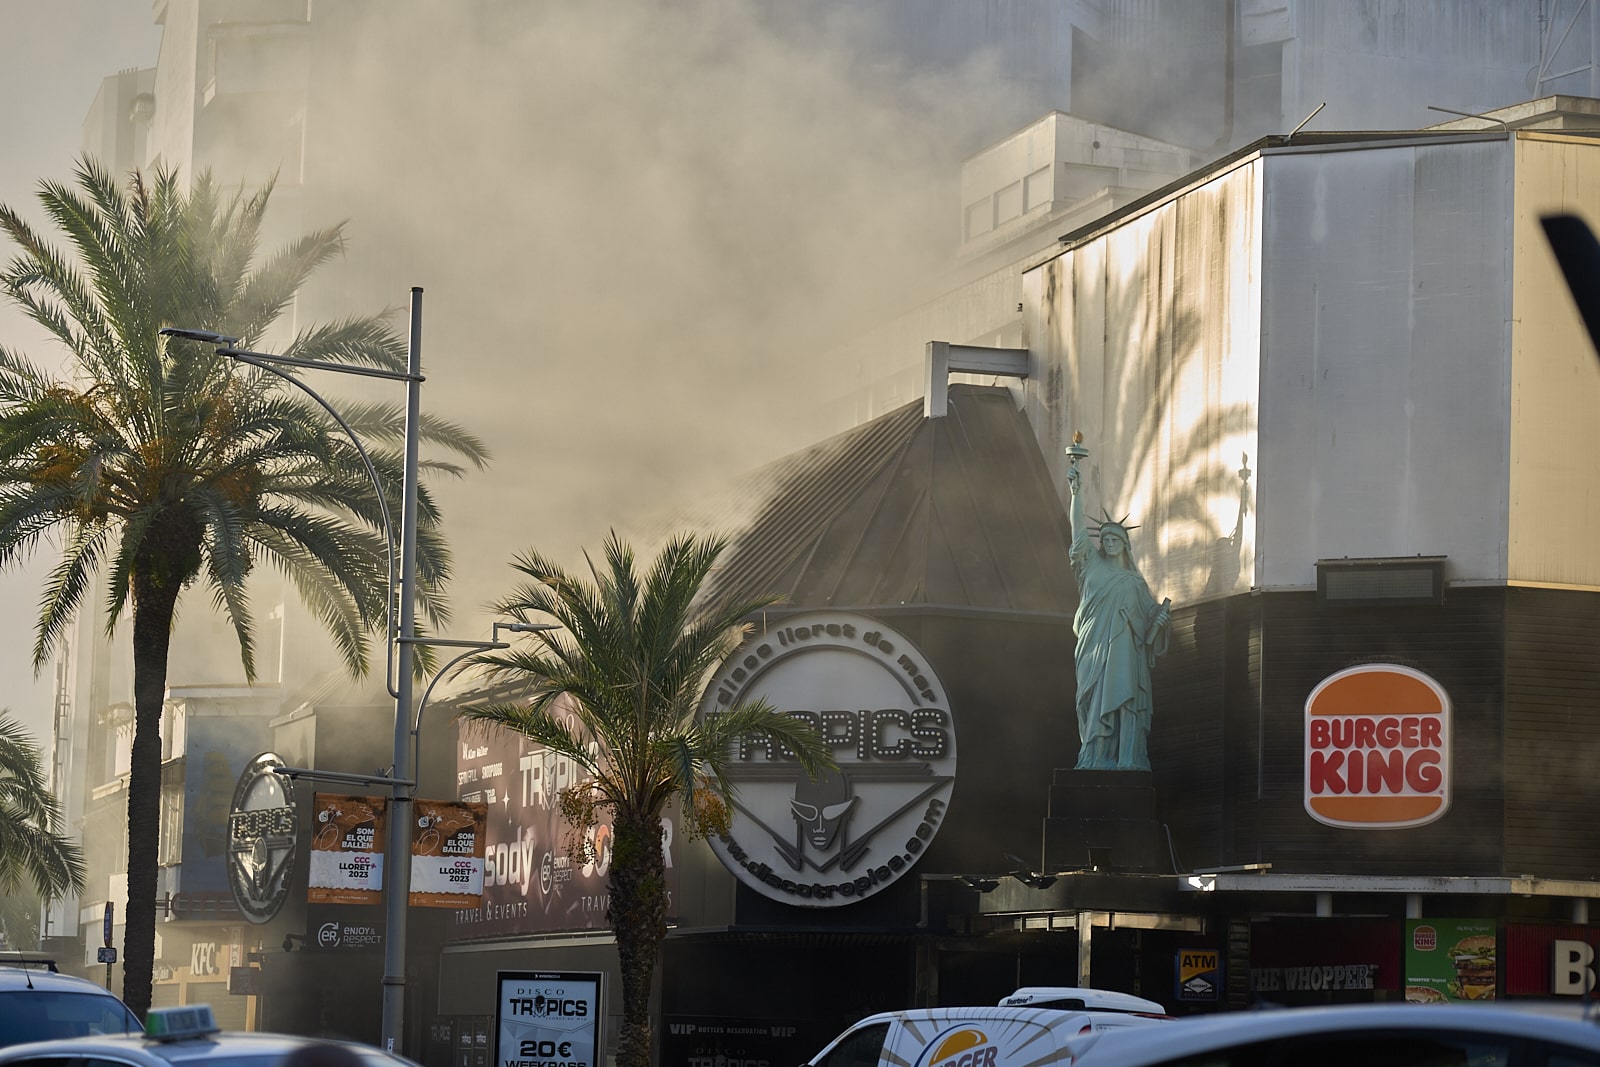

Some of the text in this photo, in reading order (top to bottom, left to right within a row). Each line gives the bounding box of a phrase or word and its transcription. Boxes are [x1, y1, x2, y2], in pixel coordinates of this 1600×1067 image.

[776, 623, 857, 648] lloret
[862, 630, 895, 655] de
[896, 653, 938, 703] mar
[1310, 717, 1443, 750] BURGER
[1309, 749, 1443, 795] KING
[356, 827, 375, 836] SOM
[457, 832, 475, 841] SOM
[346, 834, 374, 843] EL QUE
[447, 839, 475, 848] EL QUE
[341, 840, 374, 850] BALLEM
[442, 846, 474, 855] BALLEM
[353, 856, 371, 864] CCC
[454, 861, 472, 869] CCC
[484, 825, 535, 896] sody
[339, 862, 371, 872] LLORET
[439, 867, 472, 876] LLORET
[348, 870, 369, 879] 2023
[449, 875, 470, 883] 2023
[580, 894, 612, 914] TRAVE
[455, 910, 484, 925] TRAVEL
[494, 902, 528, 919] EVENTS
[1414, 938, 1436, 946] KING
[190, 942, 216, 976] KFC
[1182, 954, 1216, 969] ATM
[1554, 939, 1597, 996] B
[1284, 964, 1369, 992] WHOPPER
[517, 988, 565, 996] DISCO
[669, 1023, 697, 1035] VIP
[726, 1027, 768, 1035] RESERVATION
[770, 1026, 797, 1037] VIP
[520, 1041, 572, 1057] 20€
[696, 1047, 746, 1055] DISCO
